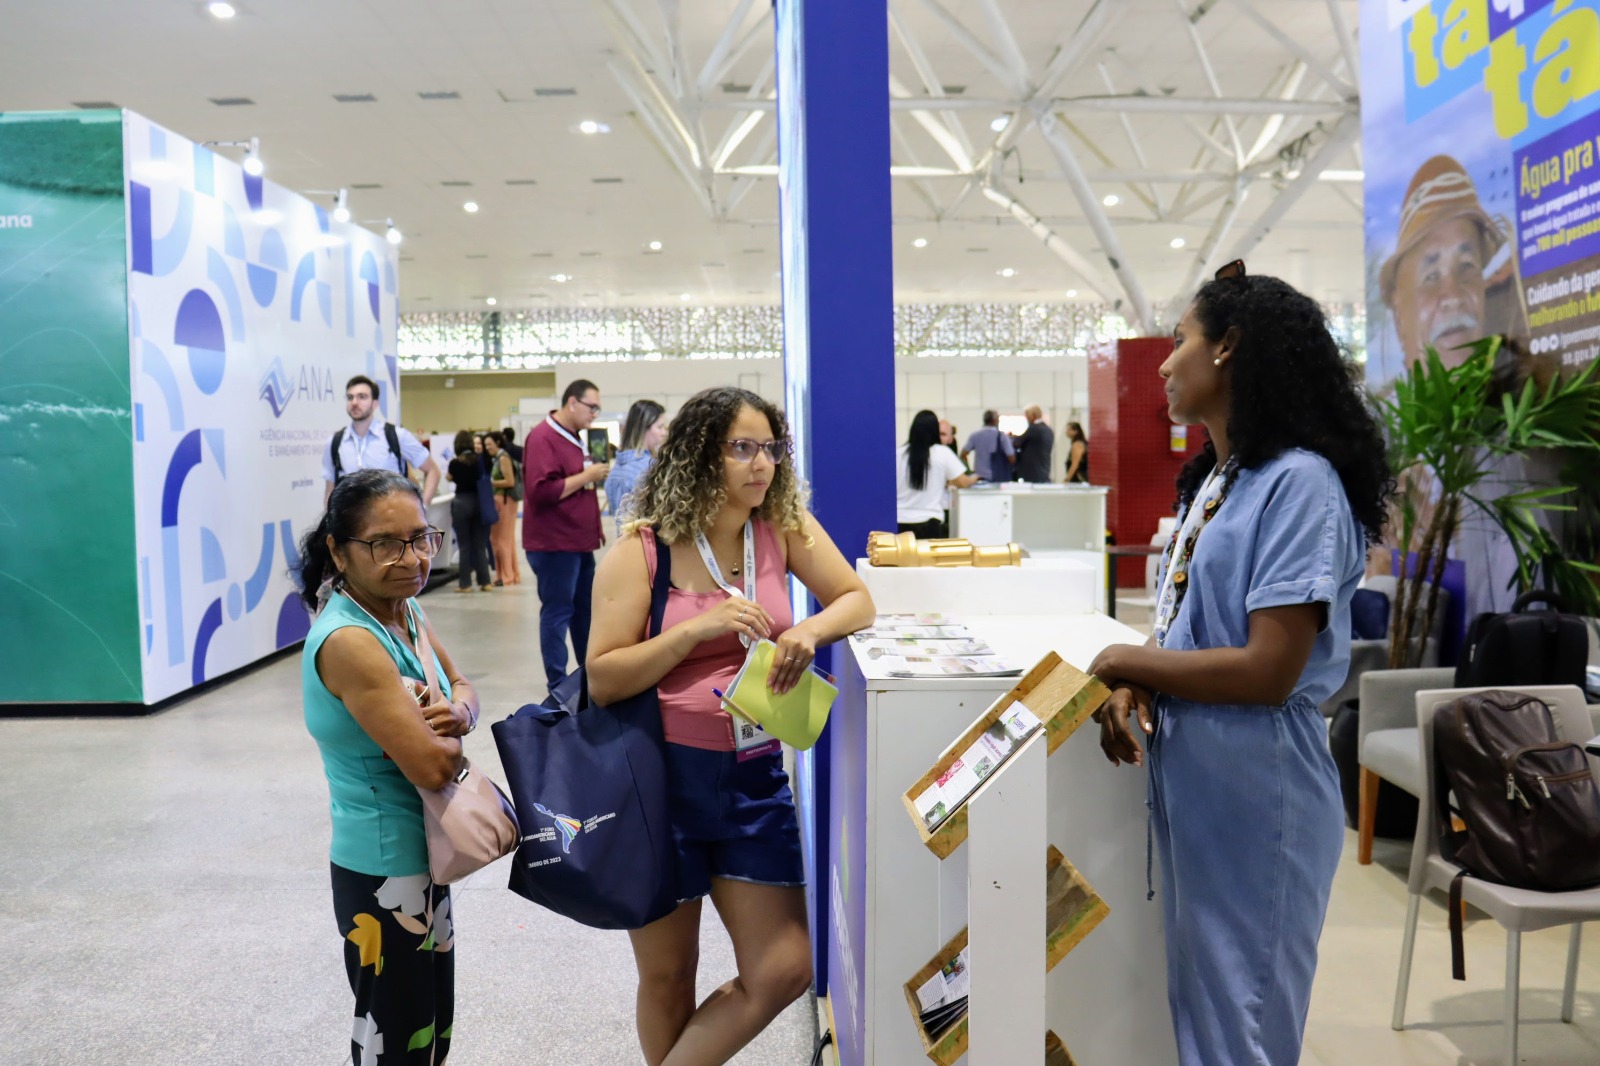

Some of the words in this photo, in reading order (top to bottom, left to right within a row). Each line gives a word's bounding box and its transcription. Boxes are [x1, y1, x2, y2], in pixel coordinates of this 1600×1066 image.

[1484, 0, 1600, 140] tá
[1520, 156, 1561, 199] Água
[1563, 140, 1593, 185] pra
[1527, 276, 1569, 307] Cuidando
[1571, 272, 1583, 293] da
[1529, 297, 1579, 328] melhorando
[1580, 299, 1587, 316] o
[298, 364, 334, 402] ANA
